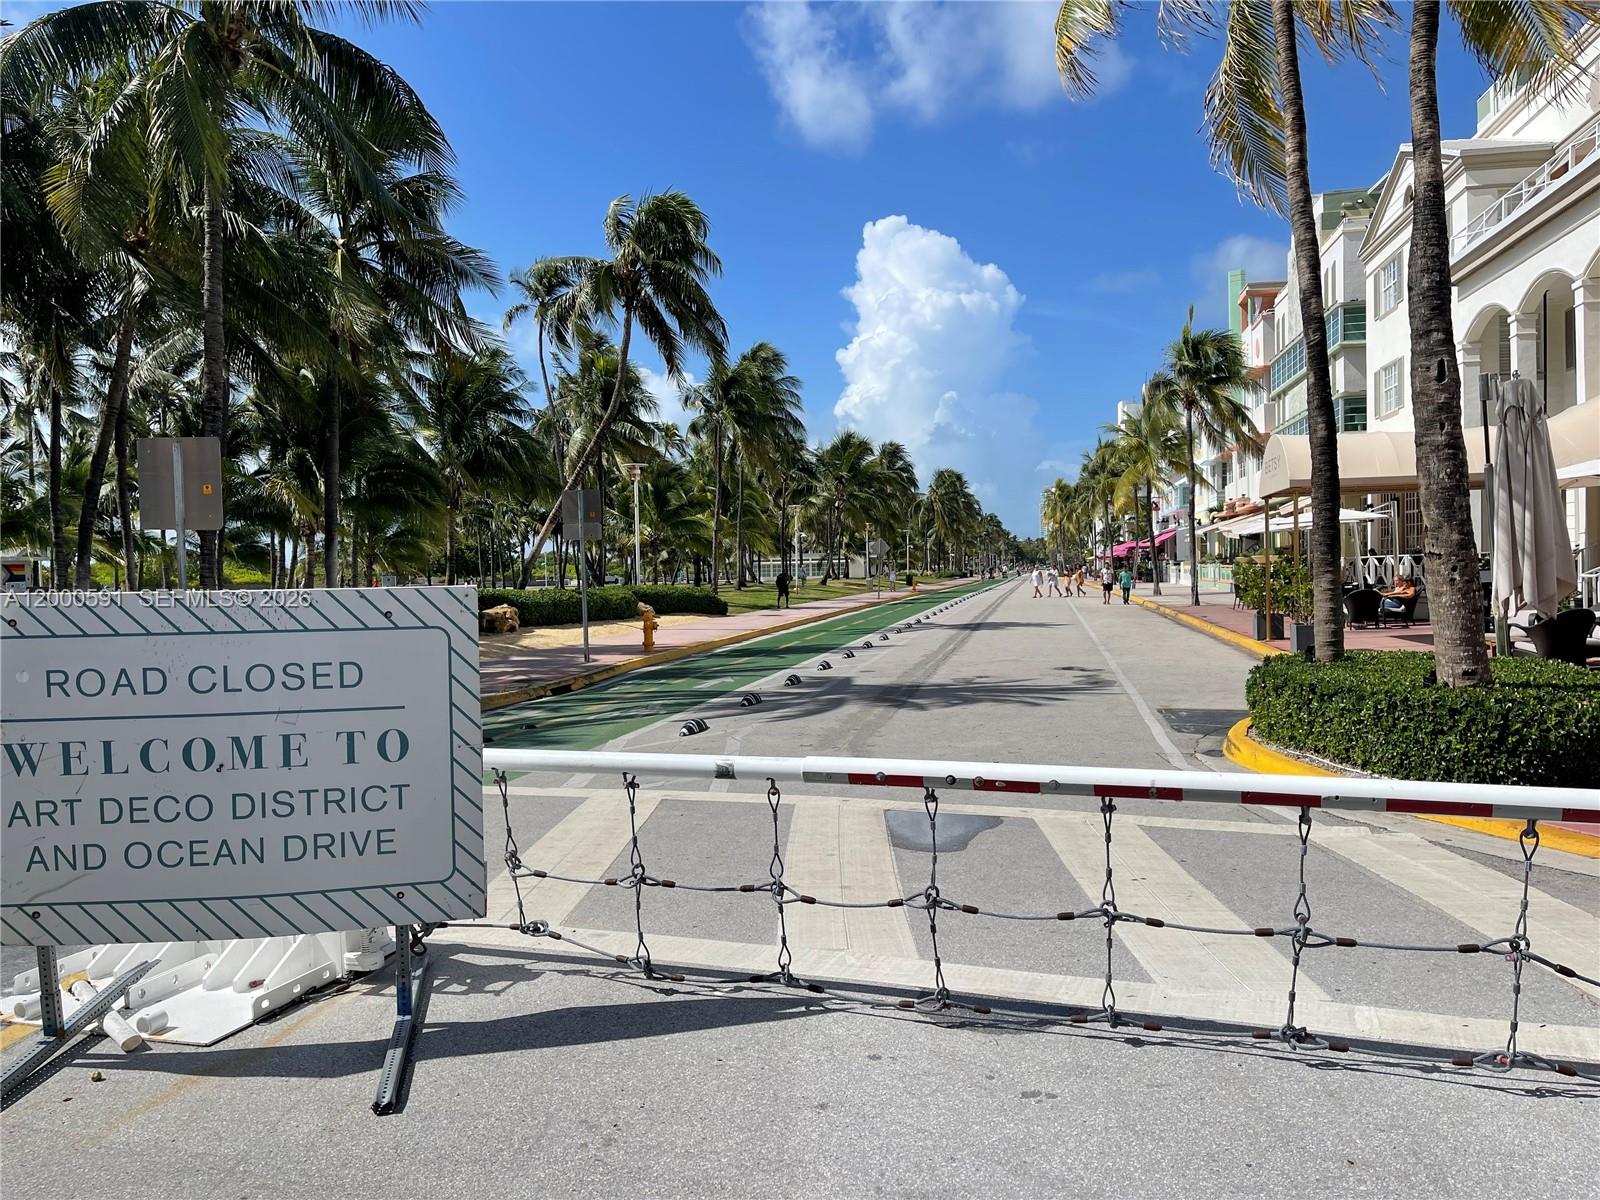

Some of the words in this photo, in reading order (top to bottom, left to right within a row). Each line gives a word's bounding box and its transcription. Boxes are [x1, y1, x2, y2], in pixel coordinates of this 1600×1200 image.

[46, 667, 168, 698] ROAD
[187, 661, 364, 695] CLOSED
[2, 732, 309, 777] WELCOME
[336, 728, 410, 765] TO
[7, 798, 83, 828] ART
[99, 794, 214, 825] DECO
[231, 783, 411, 820] DISTRICT
[26, 843, 107, 873] AND
[123, 837, 265, 869] OCEAN
[283, 828, 397, 862] DRIVE
